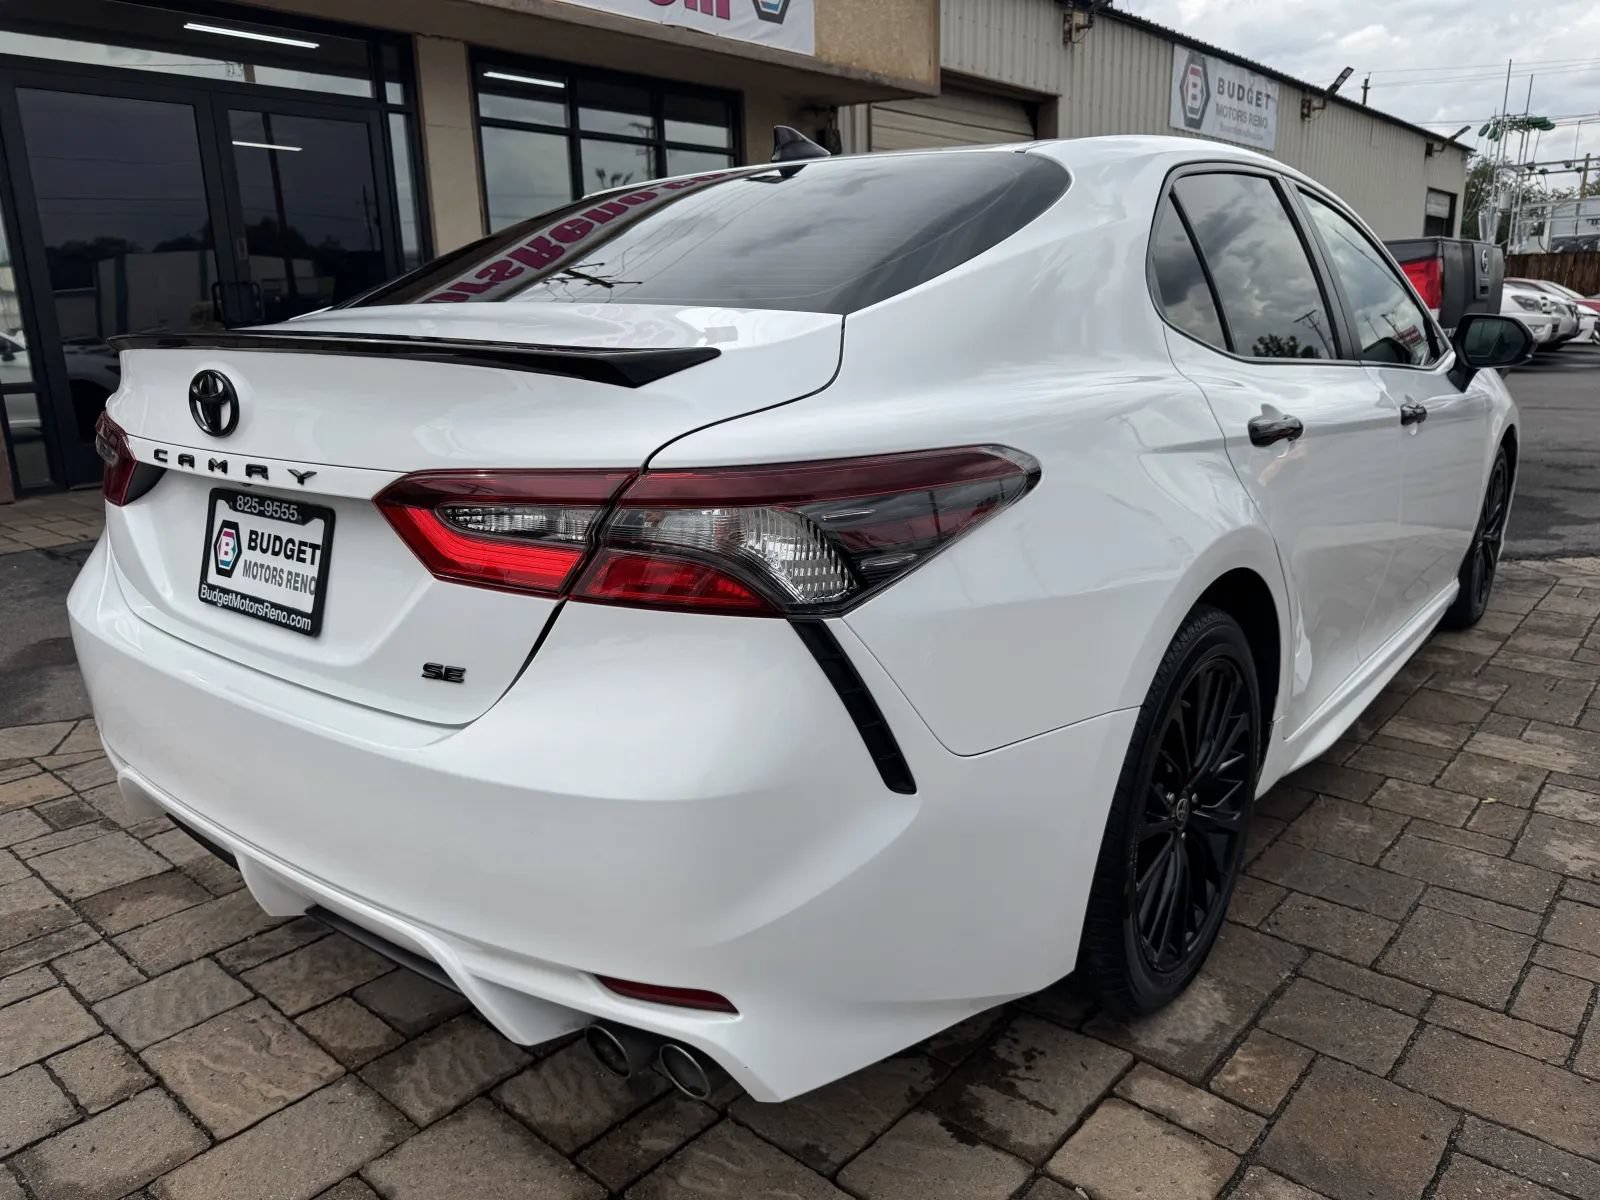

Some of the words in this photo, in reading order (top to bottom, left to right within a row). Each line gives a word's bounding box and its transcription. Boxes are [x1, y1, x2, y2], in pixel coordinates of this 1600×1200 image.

[1217, 77, 1271, 111] BUDGET
[1216, 102, 1248, 124] MOTORS
[1248, 112, 1268, 129] RENO
[153, 448, 318, 486] CAMRY
[236, 495, 299, 521] 825-9555
[247, 529, 321, 566] BUDGET
[242, 559, 285, 588] MOTORS
[285, 569, 316, 596] RENO
[200, 584, 312, 631] BudgetMotorsReno.com
[421, 662, 466, 684] SE
